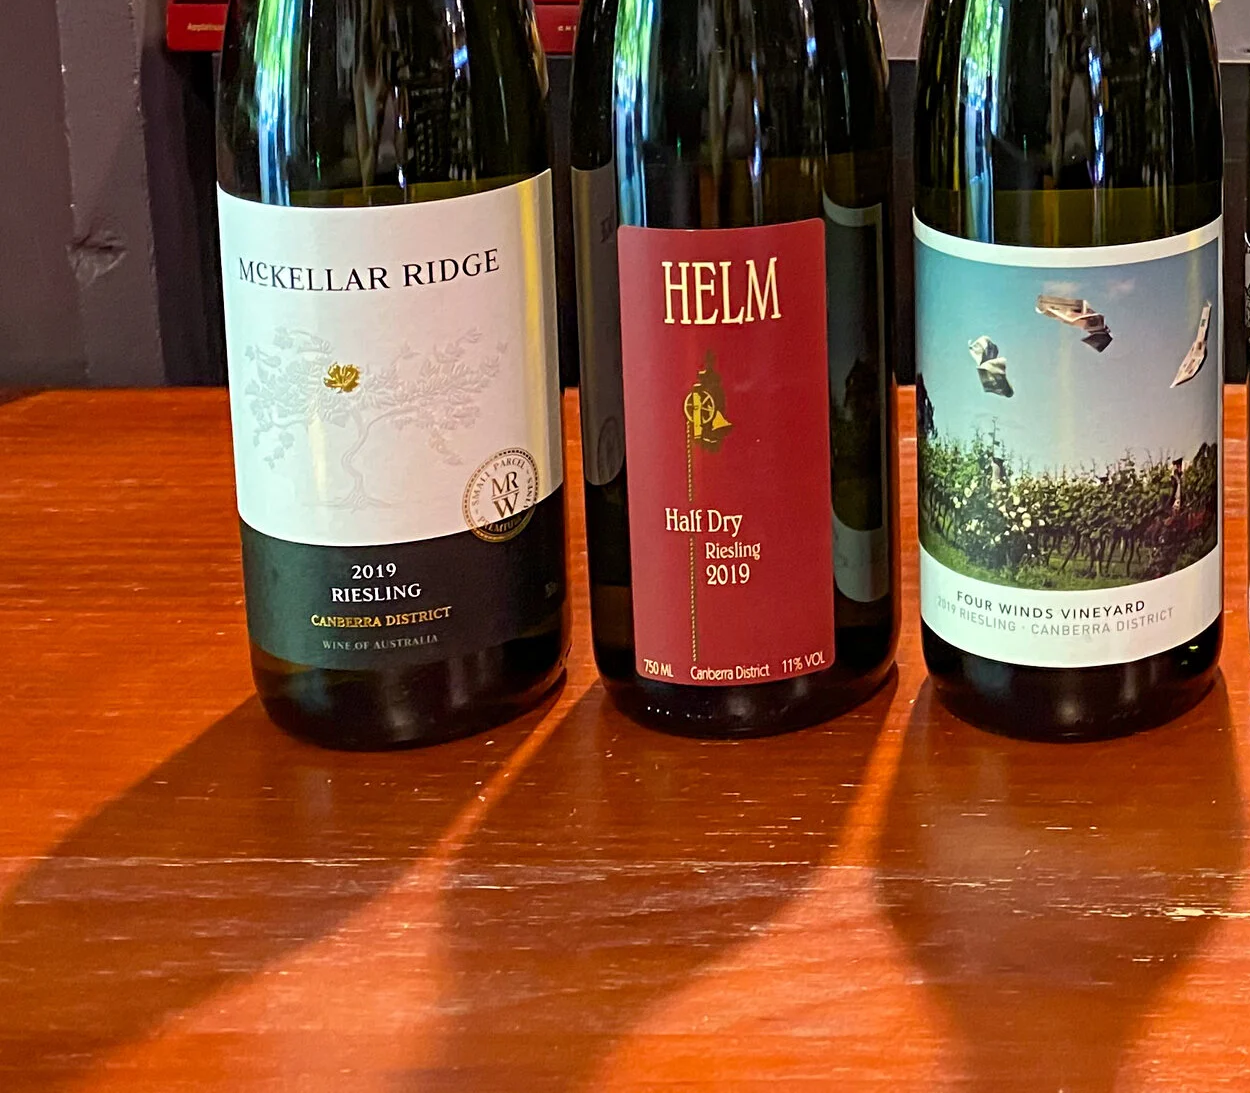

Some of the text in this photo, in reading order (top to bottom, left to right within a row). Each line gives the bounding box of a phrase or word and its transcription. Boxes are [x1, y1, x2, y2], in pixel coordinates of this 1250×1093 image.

[402, 248, 500, 287] RIDGE
[661, 257, 782, 325] HELM
[493, 457, 526, 471] PARCEL
[665, 507, 743, 537] Half Dry
[705, 542, 761, 560] Riesling
[351, 563, 398, 580] 2019
[706, 563, 751, 585] 2019
[331, 583, 422, 603] RIESLING
[937, 596, 1174, 636] 2019 RIESLING CANBERRA DISTRICT
[957, 590, 1146, 620] FOUR WINDS VINEYARD
[310, 606, 452, 628] CANBERRA DISTRICT
[322, 634, 438, 651] WINE OF AUSTRALIA
[643, 651, 825, 680] 750 ML Canberra District 11% VOL
